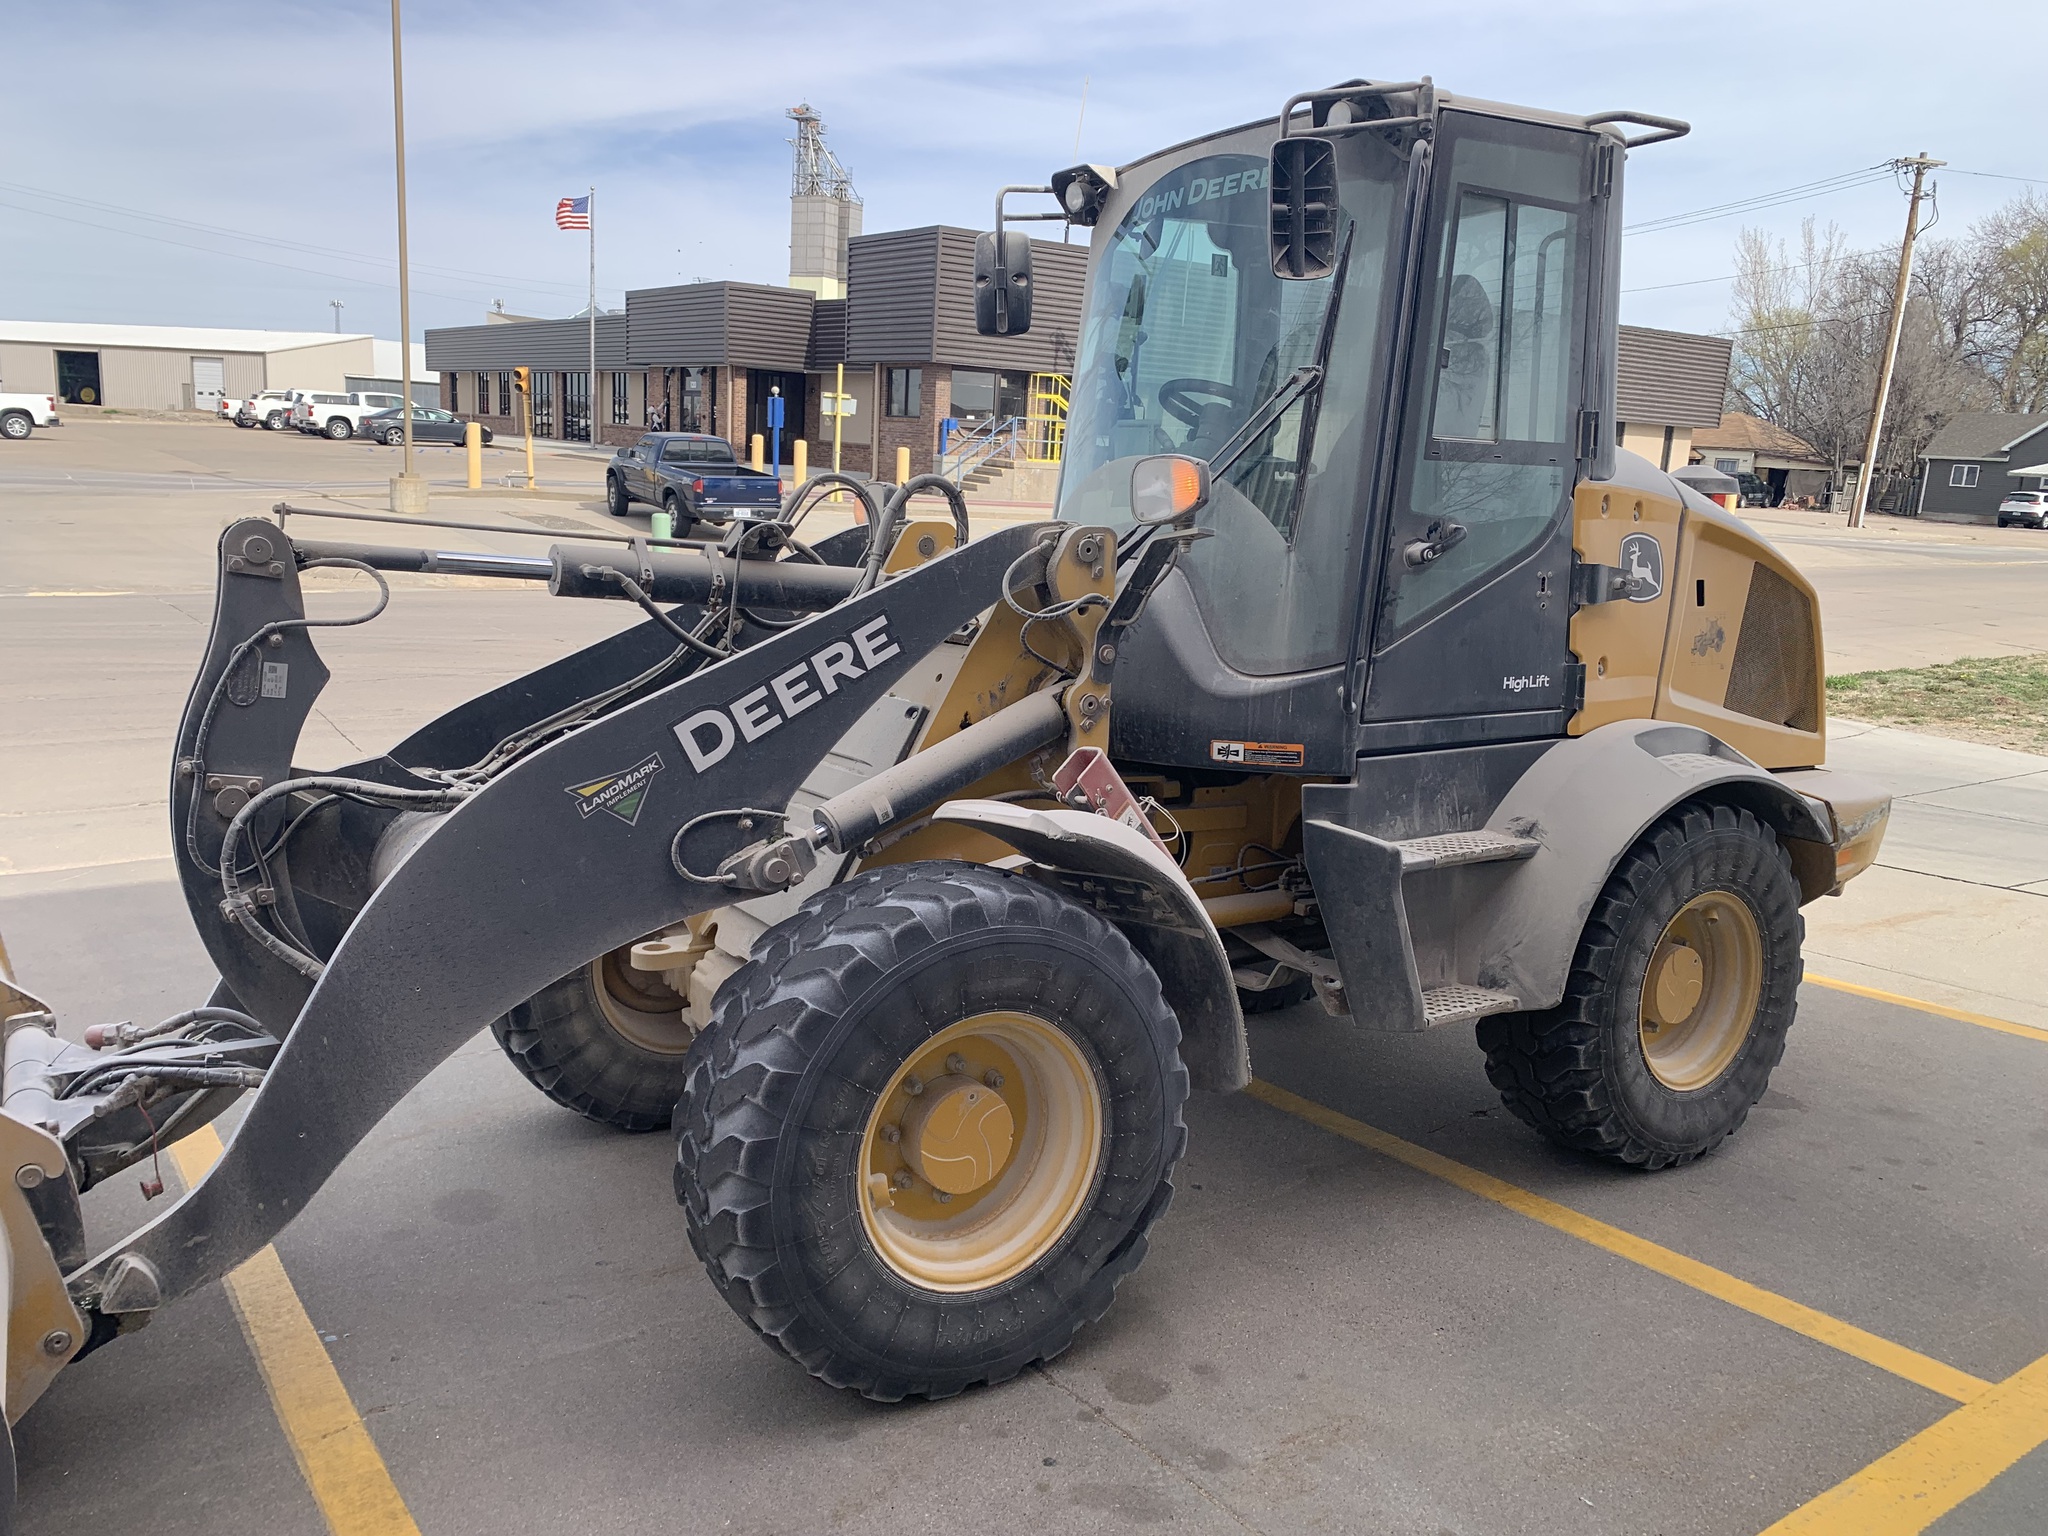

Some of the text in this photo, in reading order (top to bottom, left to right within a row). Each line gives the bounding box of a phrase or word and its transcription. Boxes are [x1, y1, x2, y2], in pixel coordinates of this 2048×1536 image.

[1133, 187, 1184, 219] JOHN
[672, 614, 901, 774] DEERE
[582, 759, 659, 813] LANDMARK
[606, 778, 647, 807] IMPLEMENT
